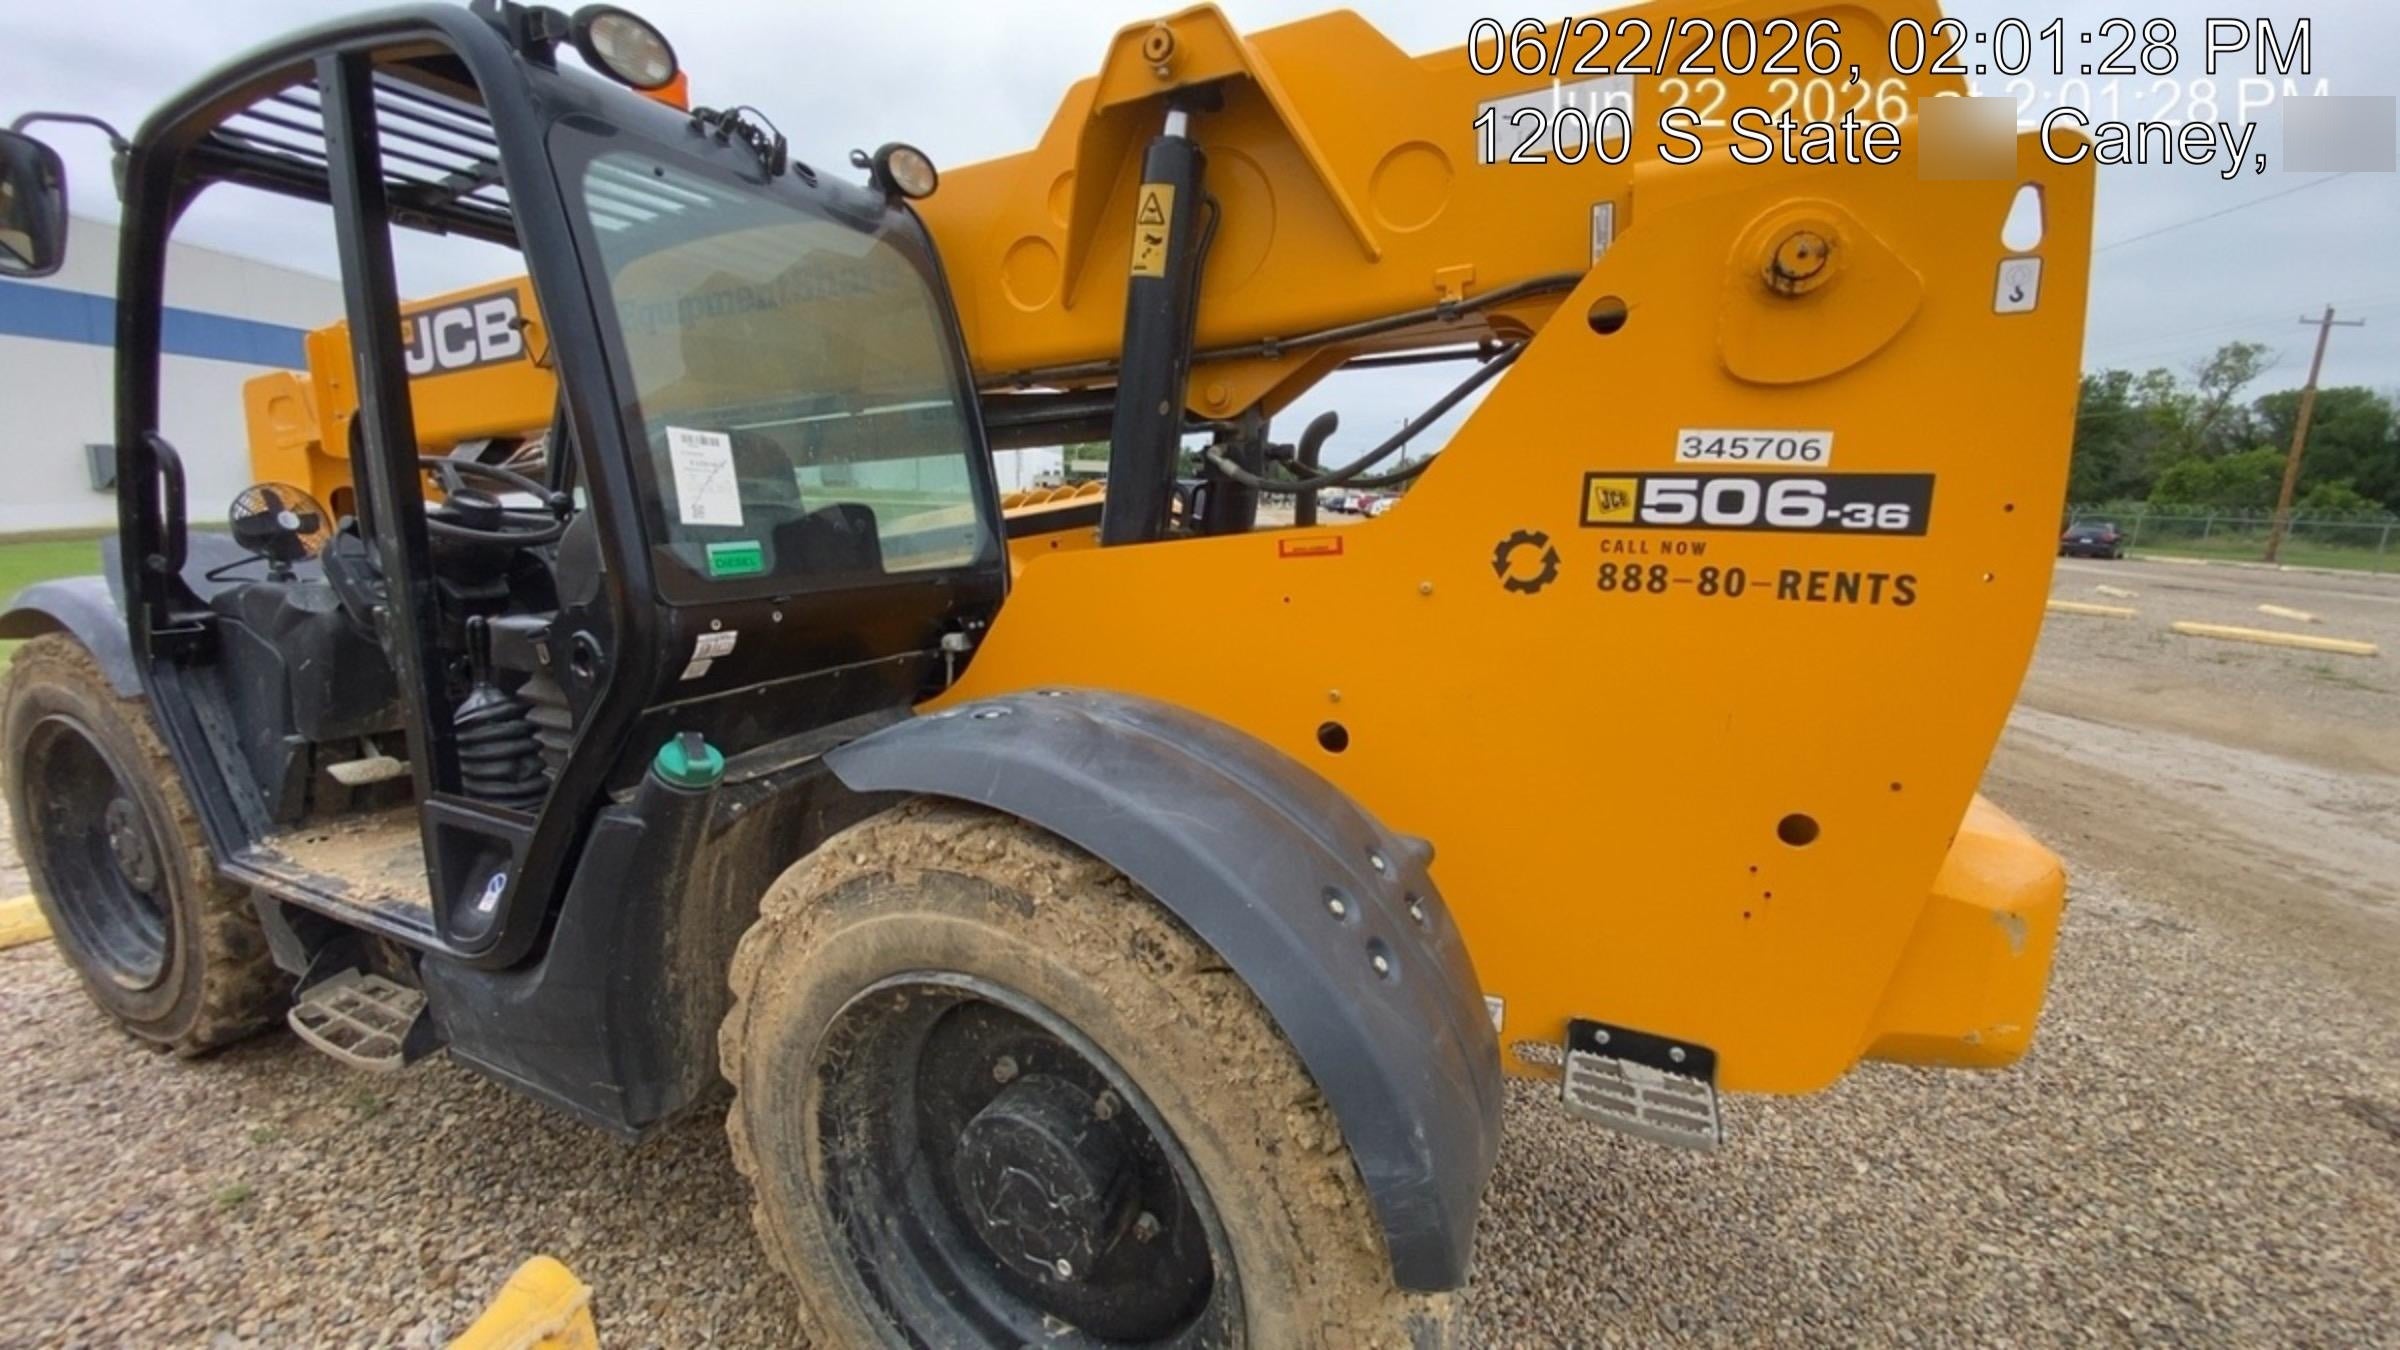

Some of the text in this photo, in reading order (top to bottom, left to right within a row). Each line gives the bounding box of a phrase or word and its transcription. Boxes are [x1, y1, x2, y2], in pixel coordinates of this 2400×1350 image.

[404, 297, 523, 376] JCB
[1681, 436, 1823, 462] 345706
[1640, 477, 1911, 530] 506-36
[1600, 539, 1708, 557] CALL NOW
[1596, 562, 1918, 607] 888-80-RENTS
